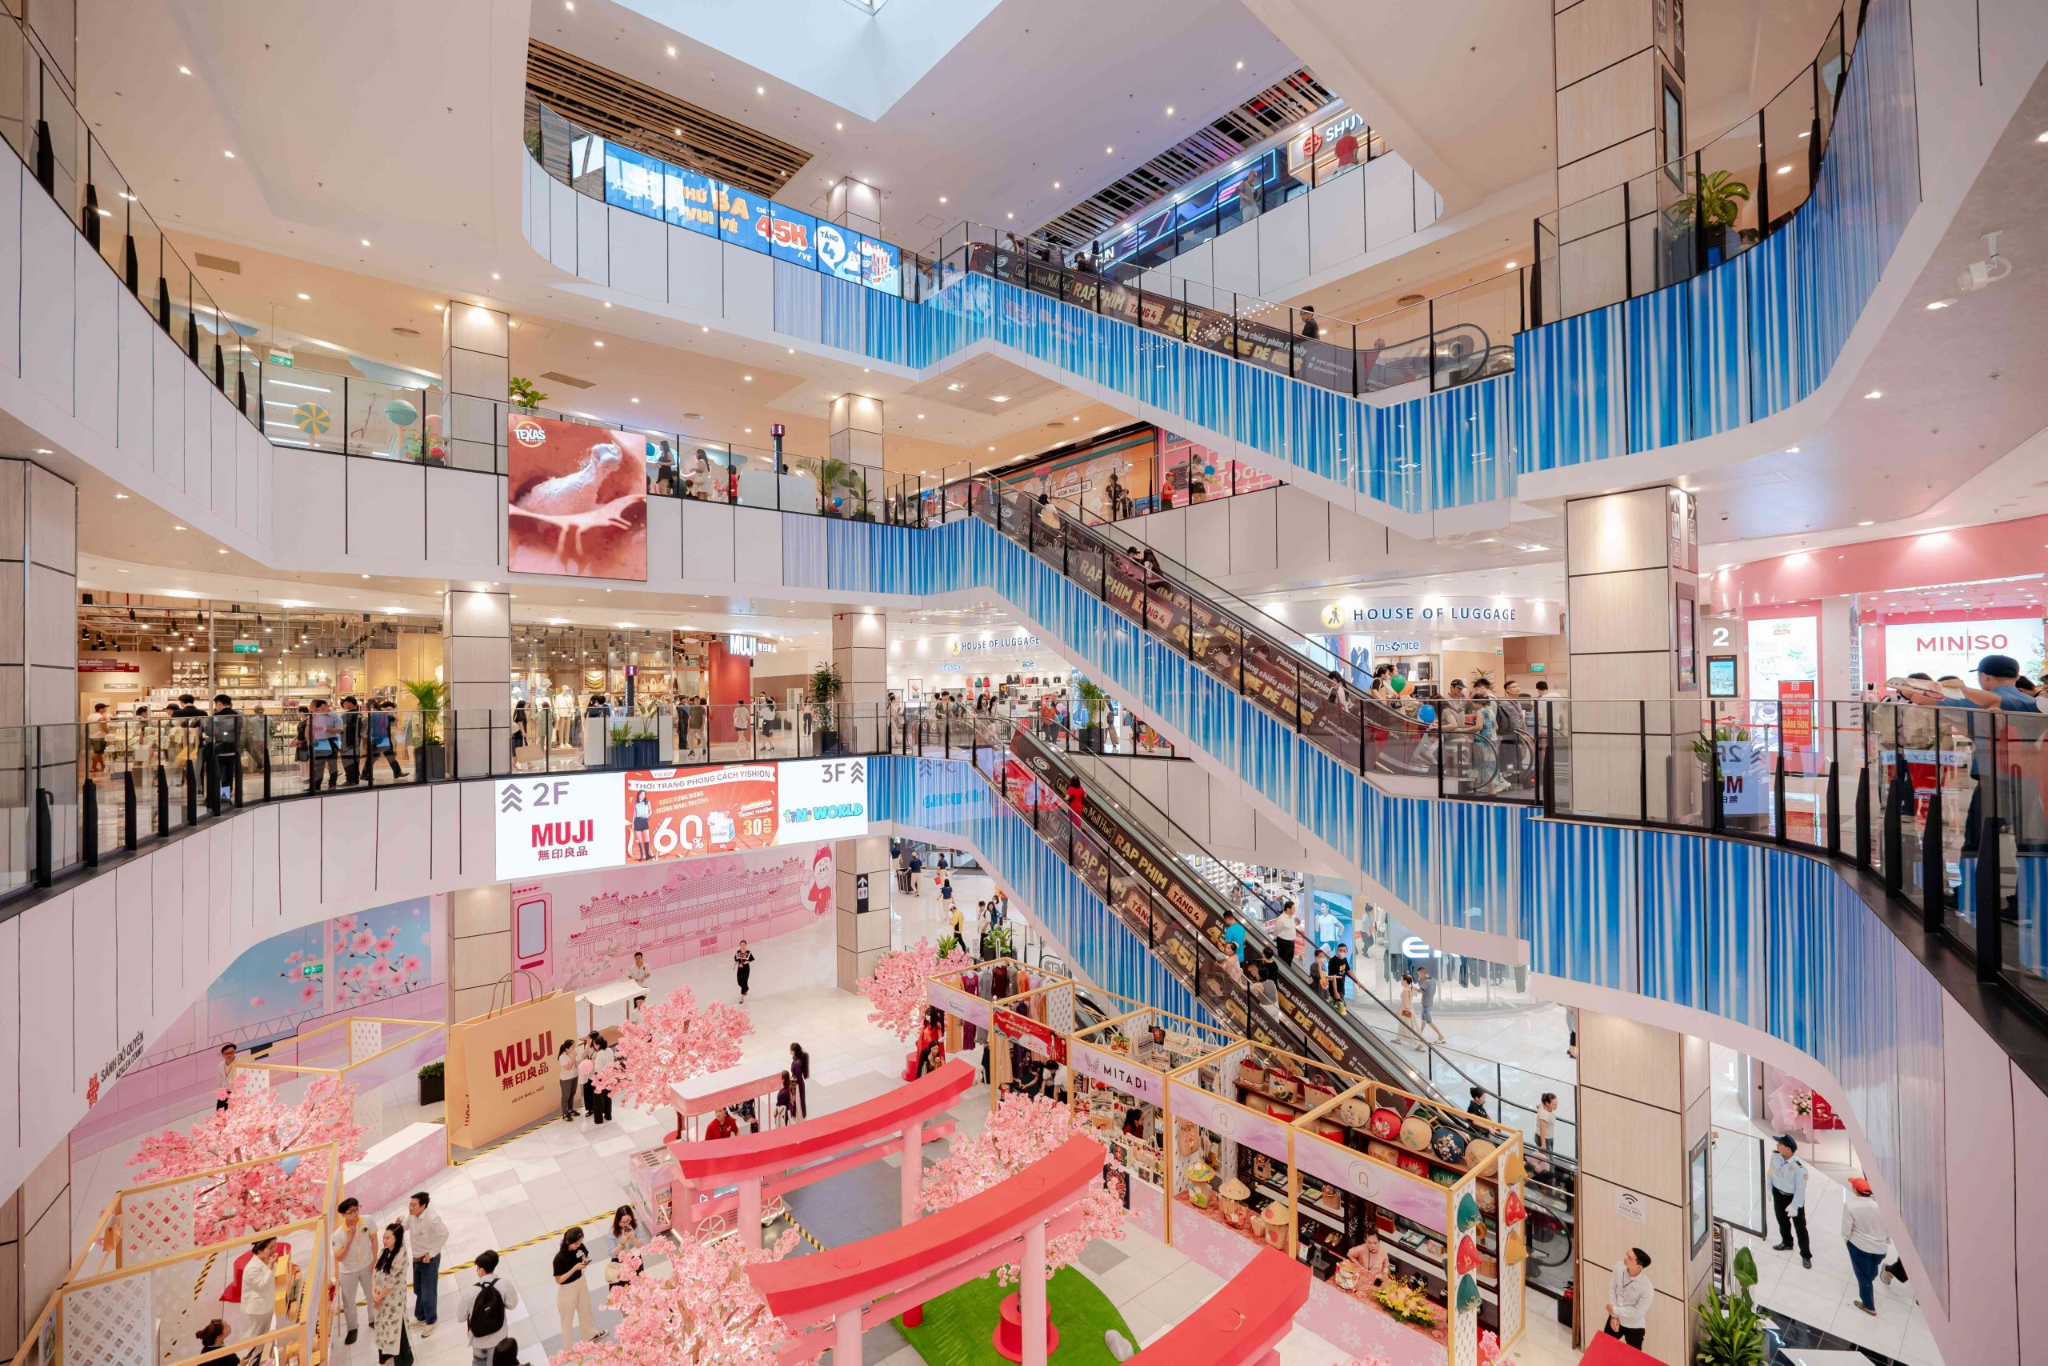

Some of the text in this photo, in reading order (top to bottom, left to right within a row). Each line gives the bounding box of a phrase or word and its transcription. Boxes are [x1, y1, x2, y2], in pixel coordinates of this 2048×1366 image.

[712, 189, 750, 220] BA
[756, 215, 808, 250] 45K
[822, 241, 836, 260] 4
[1073, 282, 1126, 311] RẠP PHIM
[1253, 346, 1270, 361] DE
[514, 428, 546, 443] TEXAS
[1080, 559, 1133, 602] RẠP PHIM
[1354, 606, 1516, 621] HOUSE OF LUGGAGE
[730, 634, 756, 656] MUJI
[962, 637, 1040, 651] HOUSE OF LUGGAGE
[1712, 627, 1731, 646] 2
[1917, 634, 2008, 652] MINISO
[1259, 670, 1277, 687] chiếu
[1277, 683, 1295, 698] phim
[1262, 687, 1281, 704] DE
[658, 781, 685, 789] TRANG
[687, 776, 715, 786] PHONG
[717, 770, 738, 783] CÁCH
[740, 770, 771, 778] YISHION
[821, 763, 846, 784] 3F
[533, 781, 570, 806] 2F
[813, 803, 864, 820] WORLD
[531, 819, 594, 848] MUJI
[538, 845, 588, 861] 無印良品
[1074, 841, 1099, 867] RẠP
[1114, 833, 1169, 889] RẠP PHIM
[1172, 890, 1200, 921] TẶNG 4
[1250, 1011, 1268, 1031] chiếu
[1268, 1028, 1286, 1048] phim
[1290, 994, 1309, 1013] chiếu
[1308, 1012, 1326, 1030] phim
[1325, 1026, 1349, 1051] Family
[1295, 1012, 1313, 1031] DE
[494, 1030, 553, 1078] MUJI
[501, 1062, 549, 1091] 無印良品
[1103, 1064, 1147, 1091] MITADI
